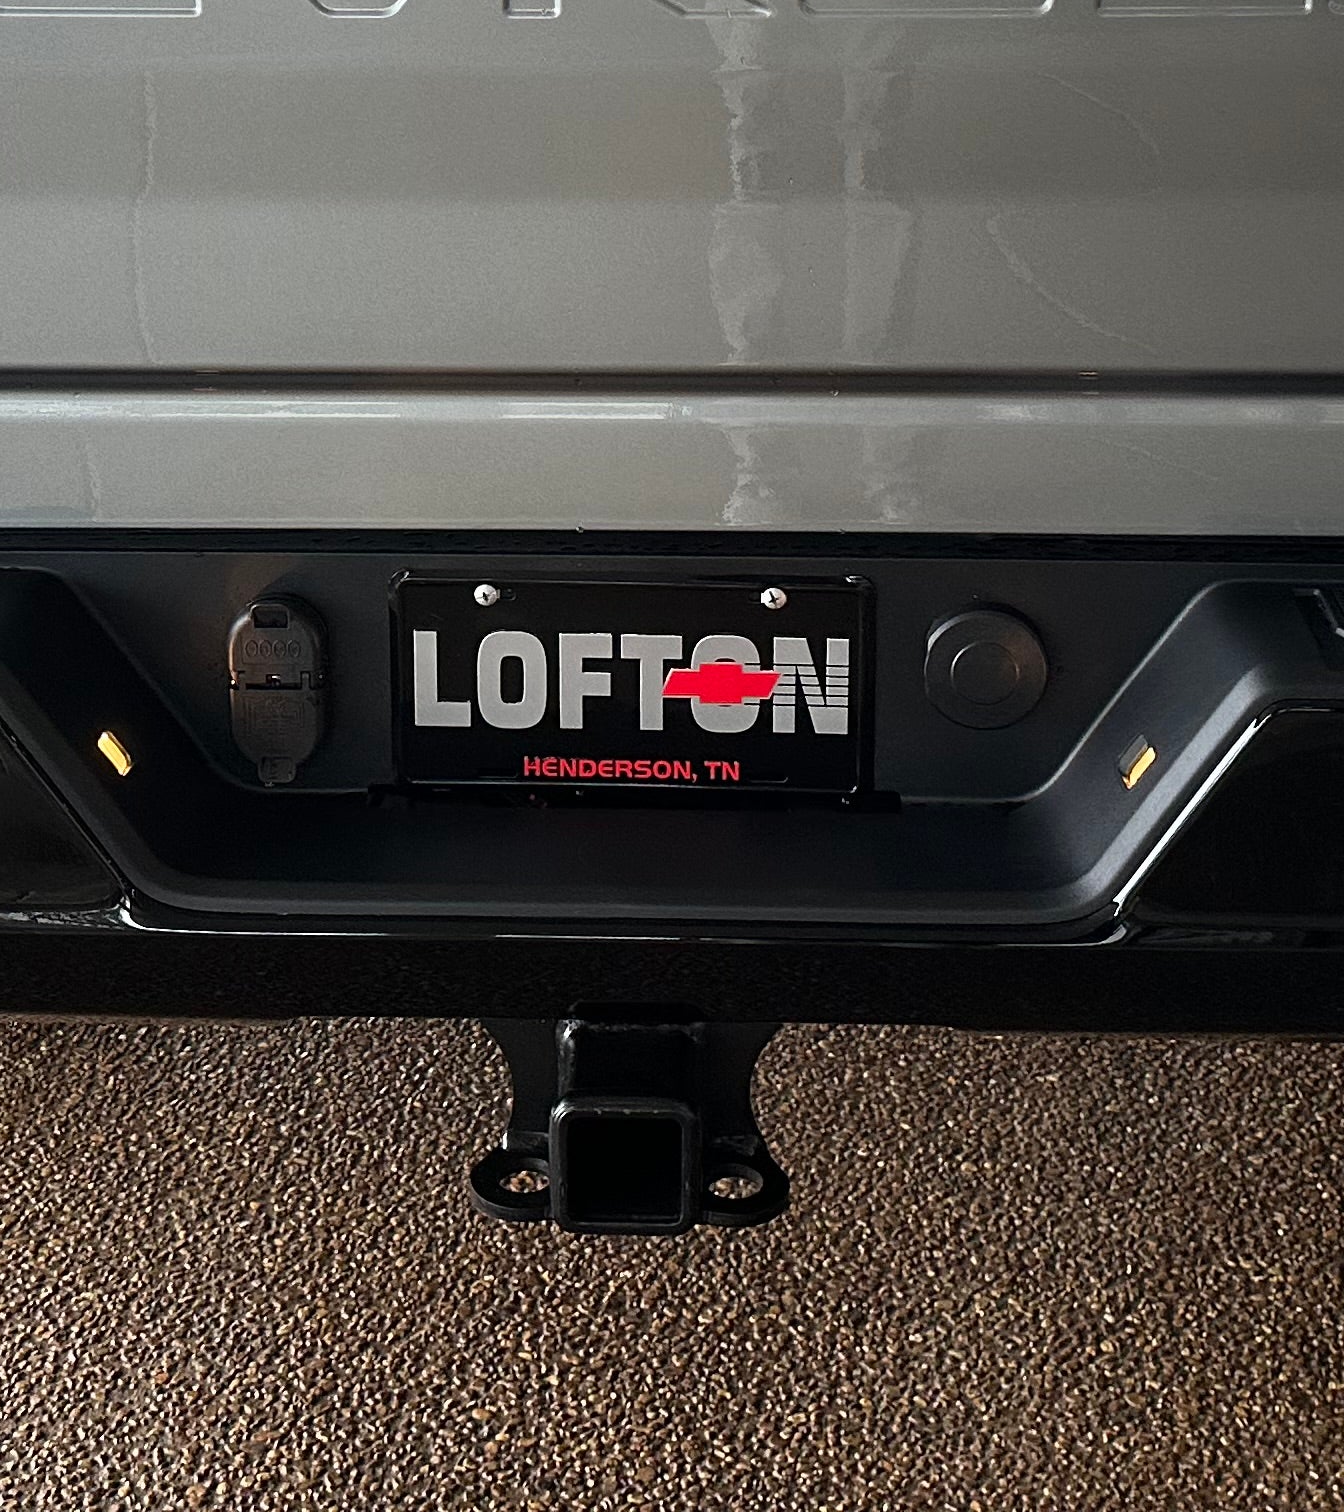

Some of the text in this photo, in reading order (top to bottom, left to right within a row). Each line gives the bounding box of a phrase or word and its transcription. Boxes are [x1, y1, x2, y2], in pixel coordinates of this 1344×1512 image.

[412, 629, 850, 735] LOFTON
[523, 756, 740, 782] HENDERSON, TN
